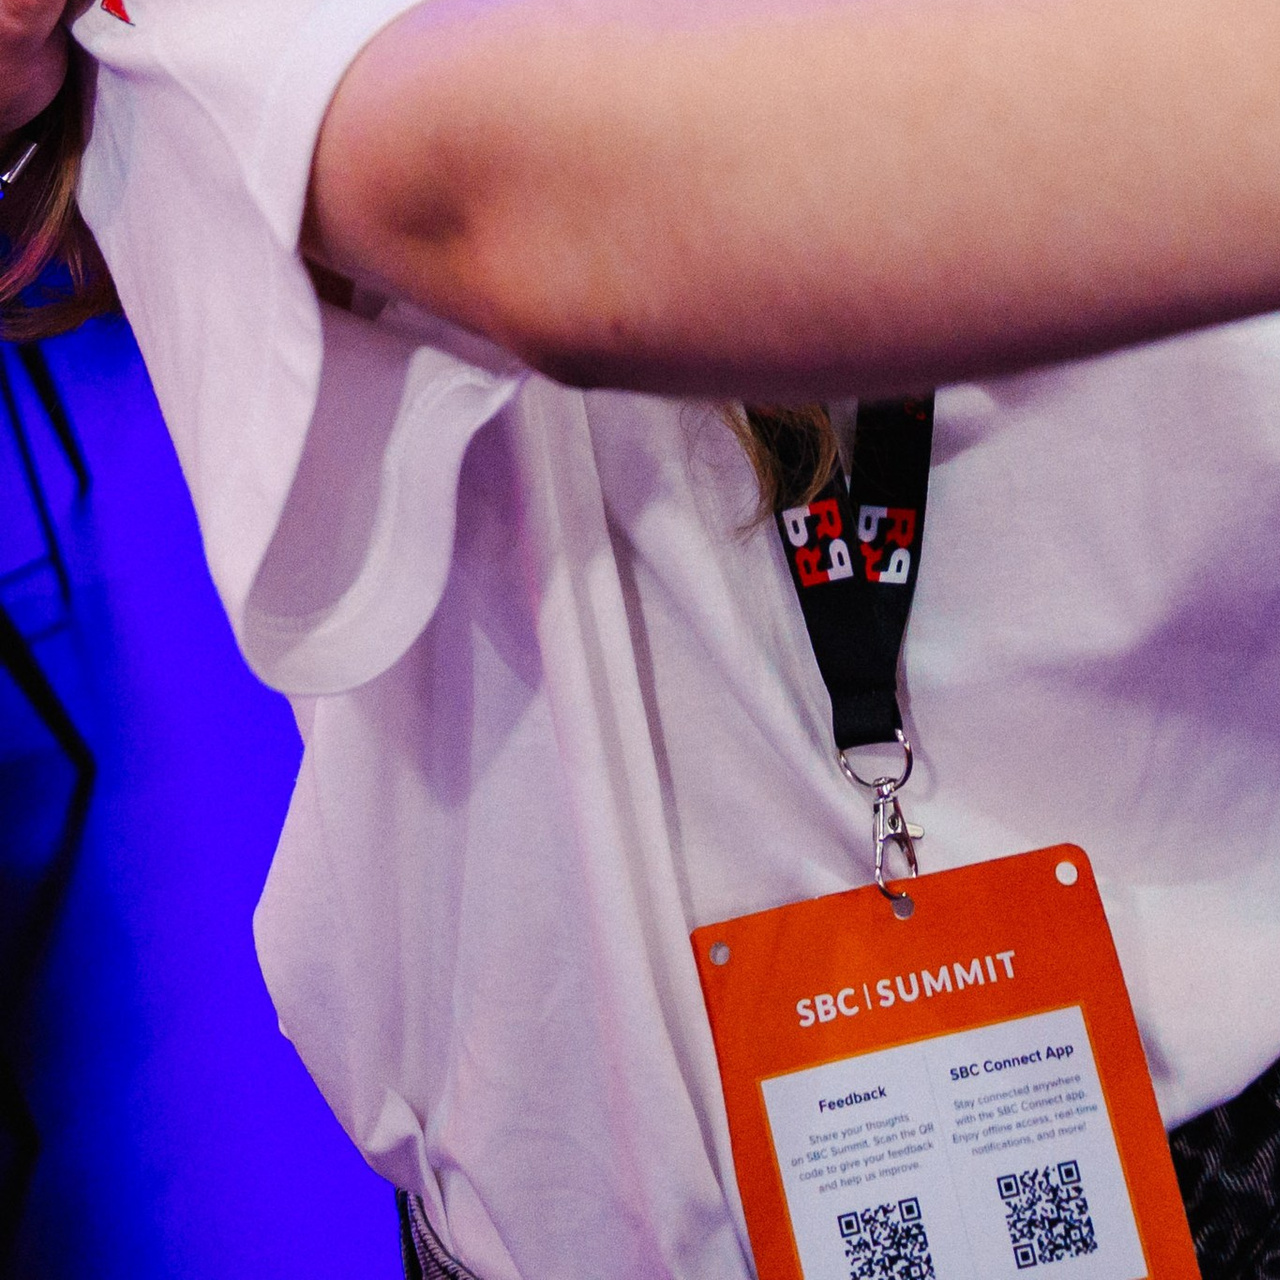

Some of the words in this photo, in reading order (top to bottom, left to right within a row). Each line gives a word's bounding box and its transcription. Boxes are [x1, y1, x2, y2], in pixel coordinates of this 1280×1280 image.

[950, 1063, 980, 1081] SBC
[983, 1050, 1042, 1073] Connect
[1045, 1044, 1074, 1061] App
[818, 1086, 887, 1113] Feedback
[953, 1098, 975, 1112] Stay
[977, 1085, 1030, 1105] connected
[1032, 1074, 1081, 1091] anywhere
[955, 1114, 976, 1127] with
[978, 1109, 995, 1121] the
[997, 1104, 1019, 1117] SBC
[1021, 1094, 1063, 1112] Connect
[791, 1155, 804, 1168] on
[806, 1148, 829, 1163] SBC
[873, 1133, 898, 1147] Scan
[900, 1127, 916, 1142] the
[918, 1123, 935, 1136] QR
[808, 1131, 839, 1146] Share
[841, 1124, 863, 1139] your
[865, 1113, 910, 1132] thoughts
[952, 1128, 979, 1144] Enjoy
[982, 1121, 1013, 1137] offline
[1037, 1129, 1056, 1142] and
[799, 1168, 824, 1182] code
[826, 1165, 838, 1176] to
[840, 1159, 861, 1174] give
[863, 1152, 885, 1167] your
[887, 1141, 934, 1159] feedback
[818, 1180, 838, 1194] and
[840, 1174, 862, 1190] help
[865, 1171, 876, 1181] us
